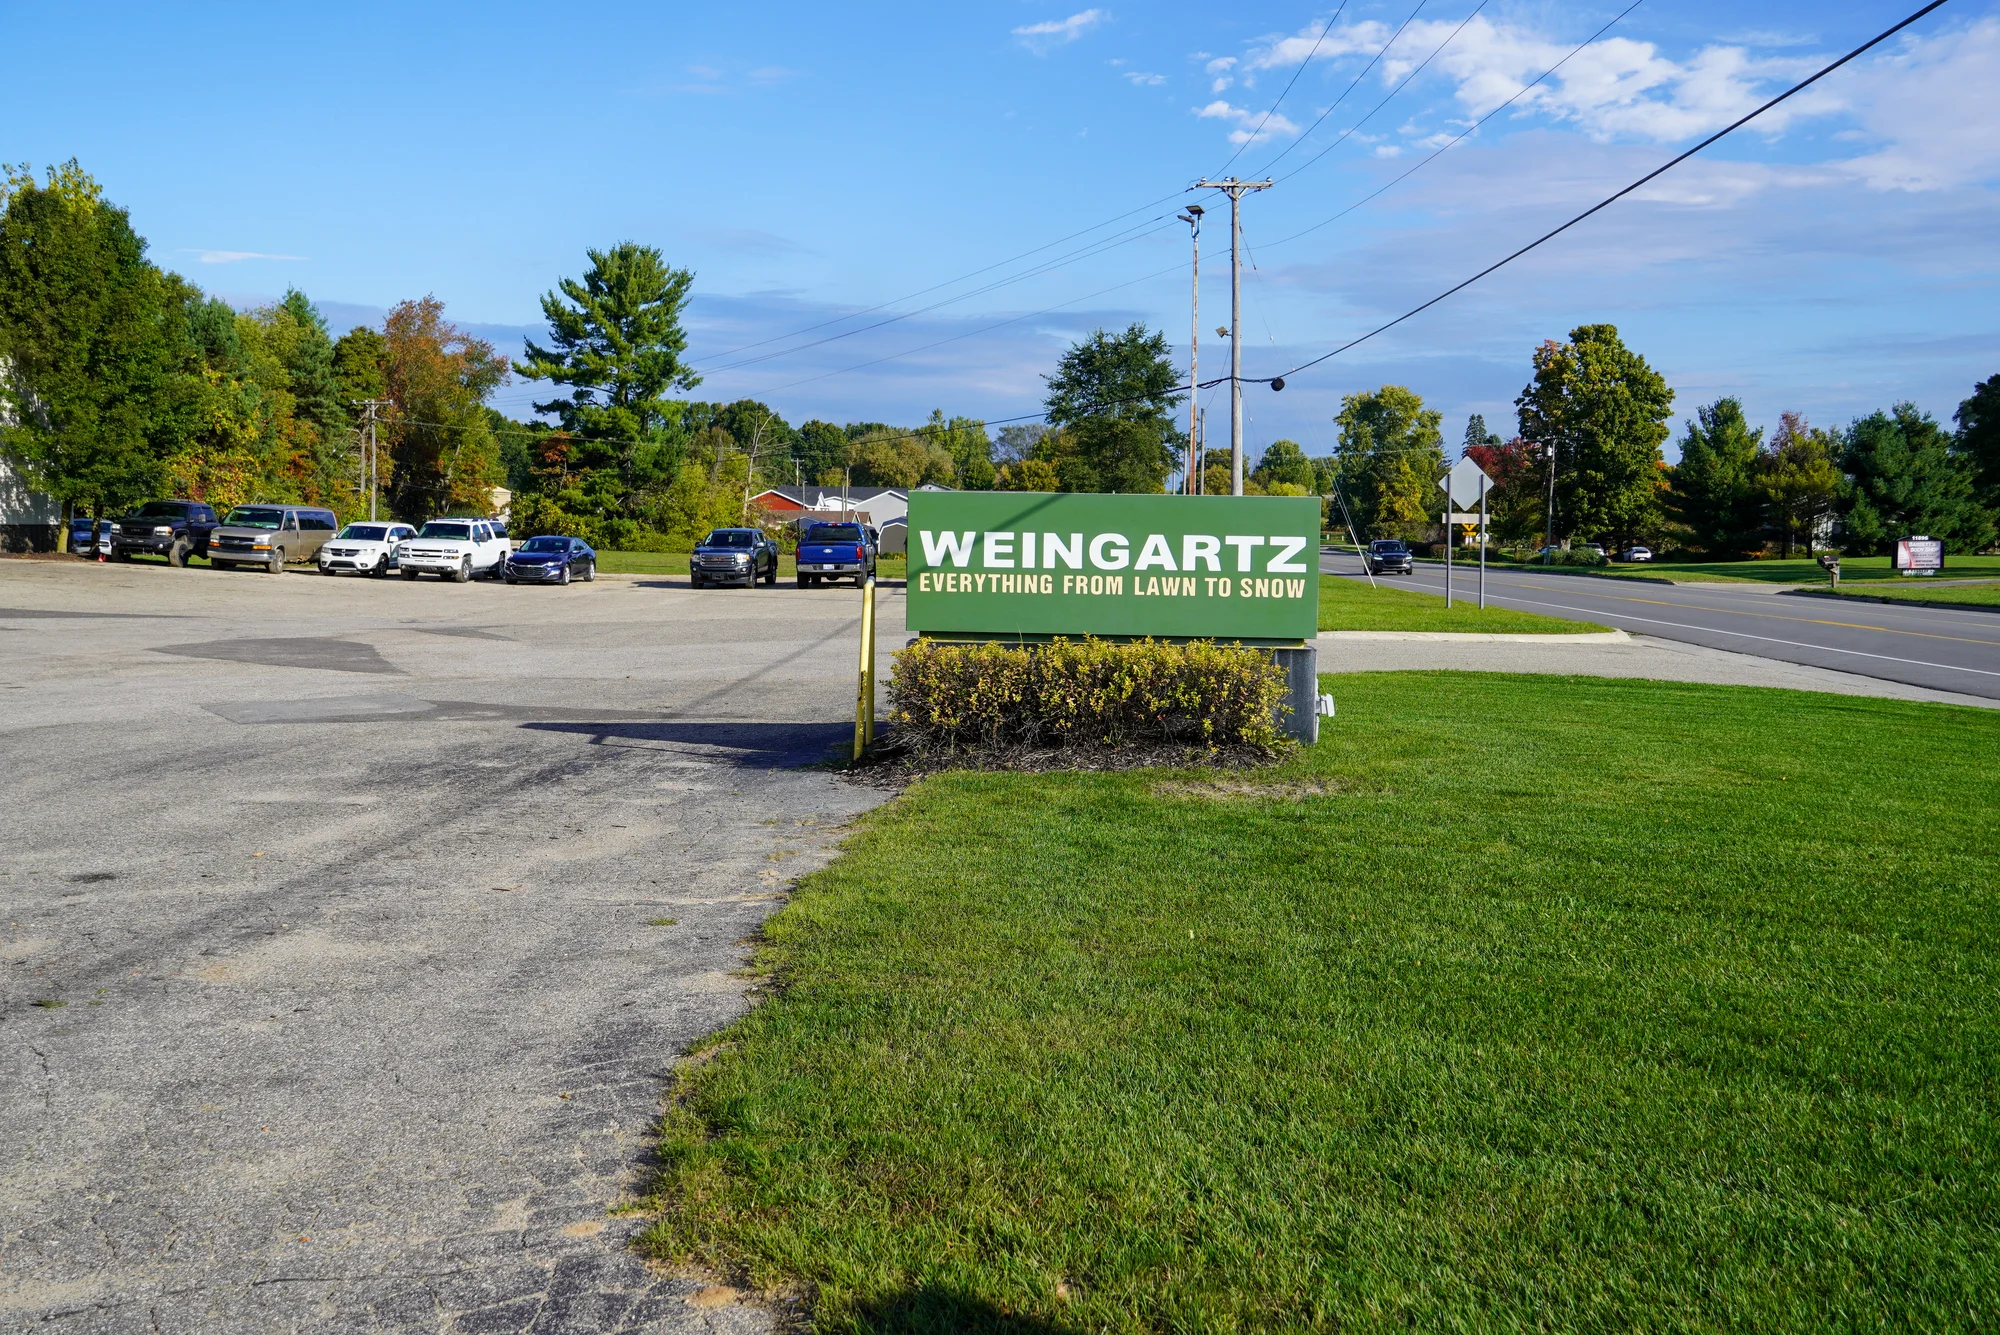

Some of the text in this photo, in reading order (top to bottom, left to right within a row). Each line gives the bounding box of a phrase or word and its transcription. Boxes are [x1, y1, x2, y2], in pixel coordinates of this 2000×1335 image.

[918, 530, 1307, 573] WEINGARTZ
[919, 572, 1306, 599] EVERYTHING FROM LAWN TO SNOW
